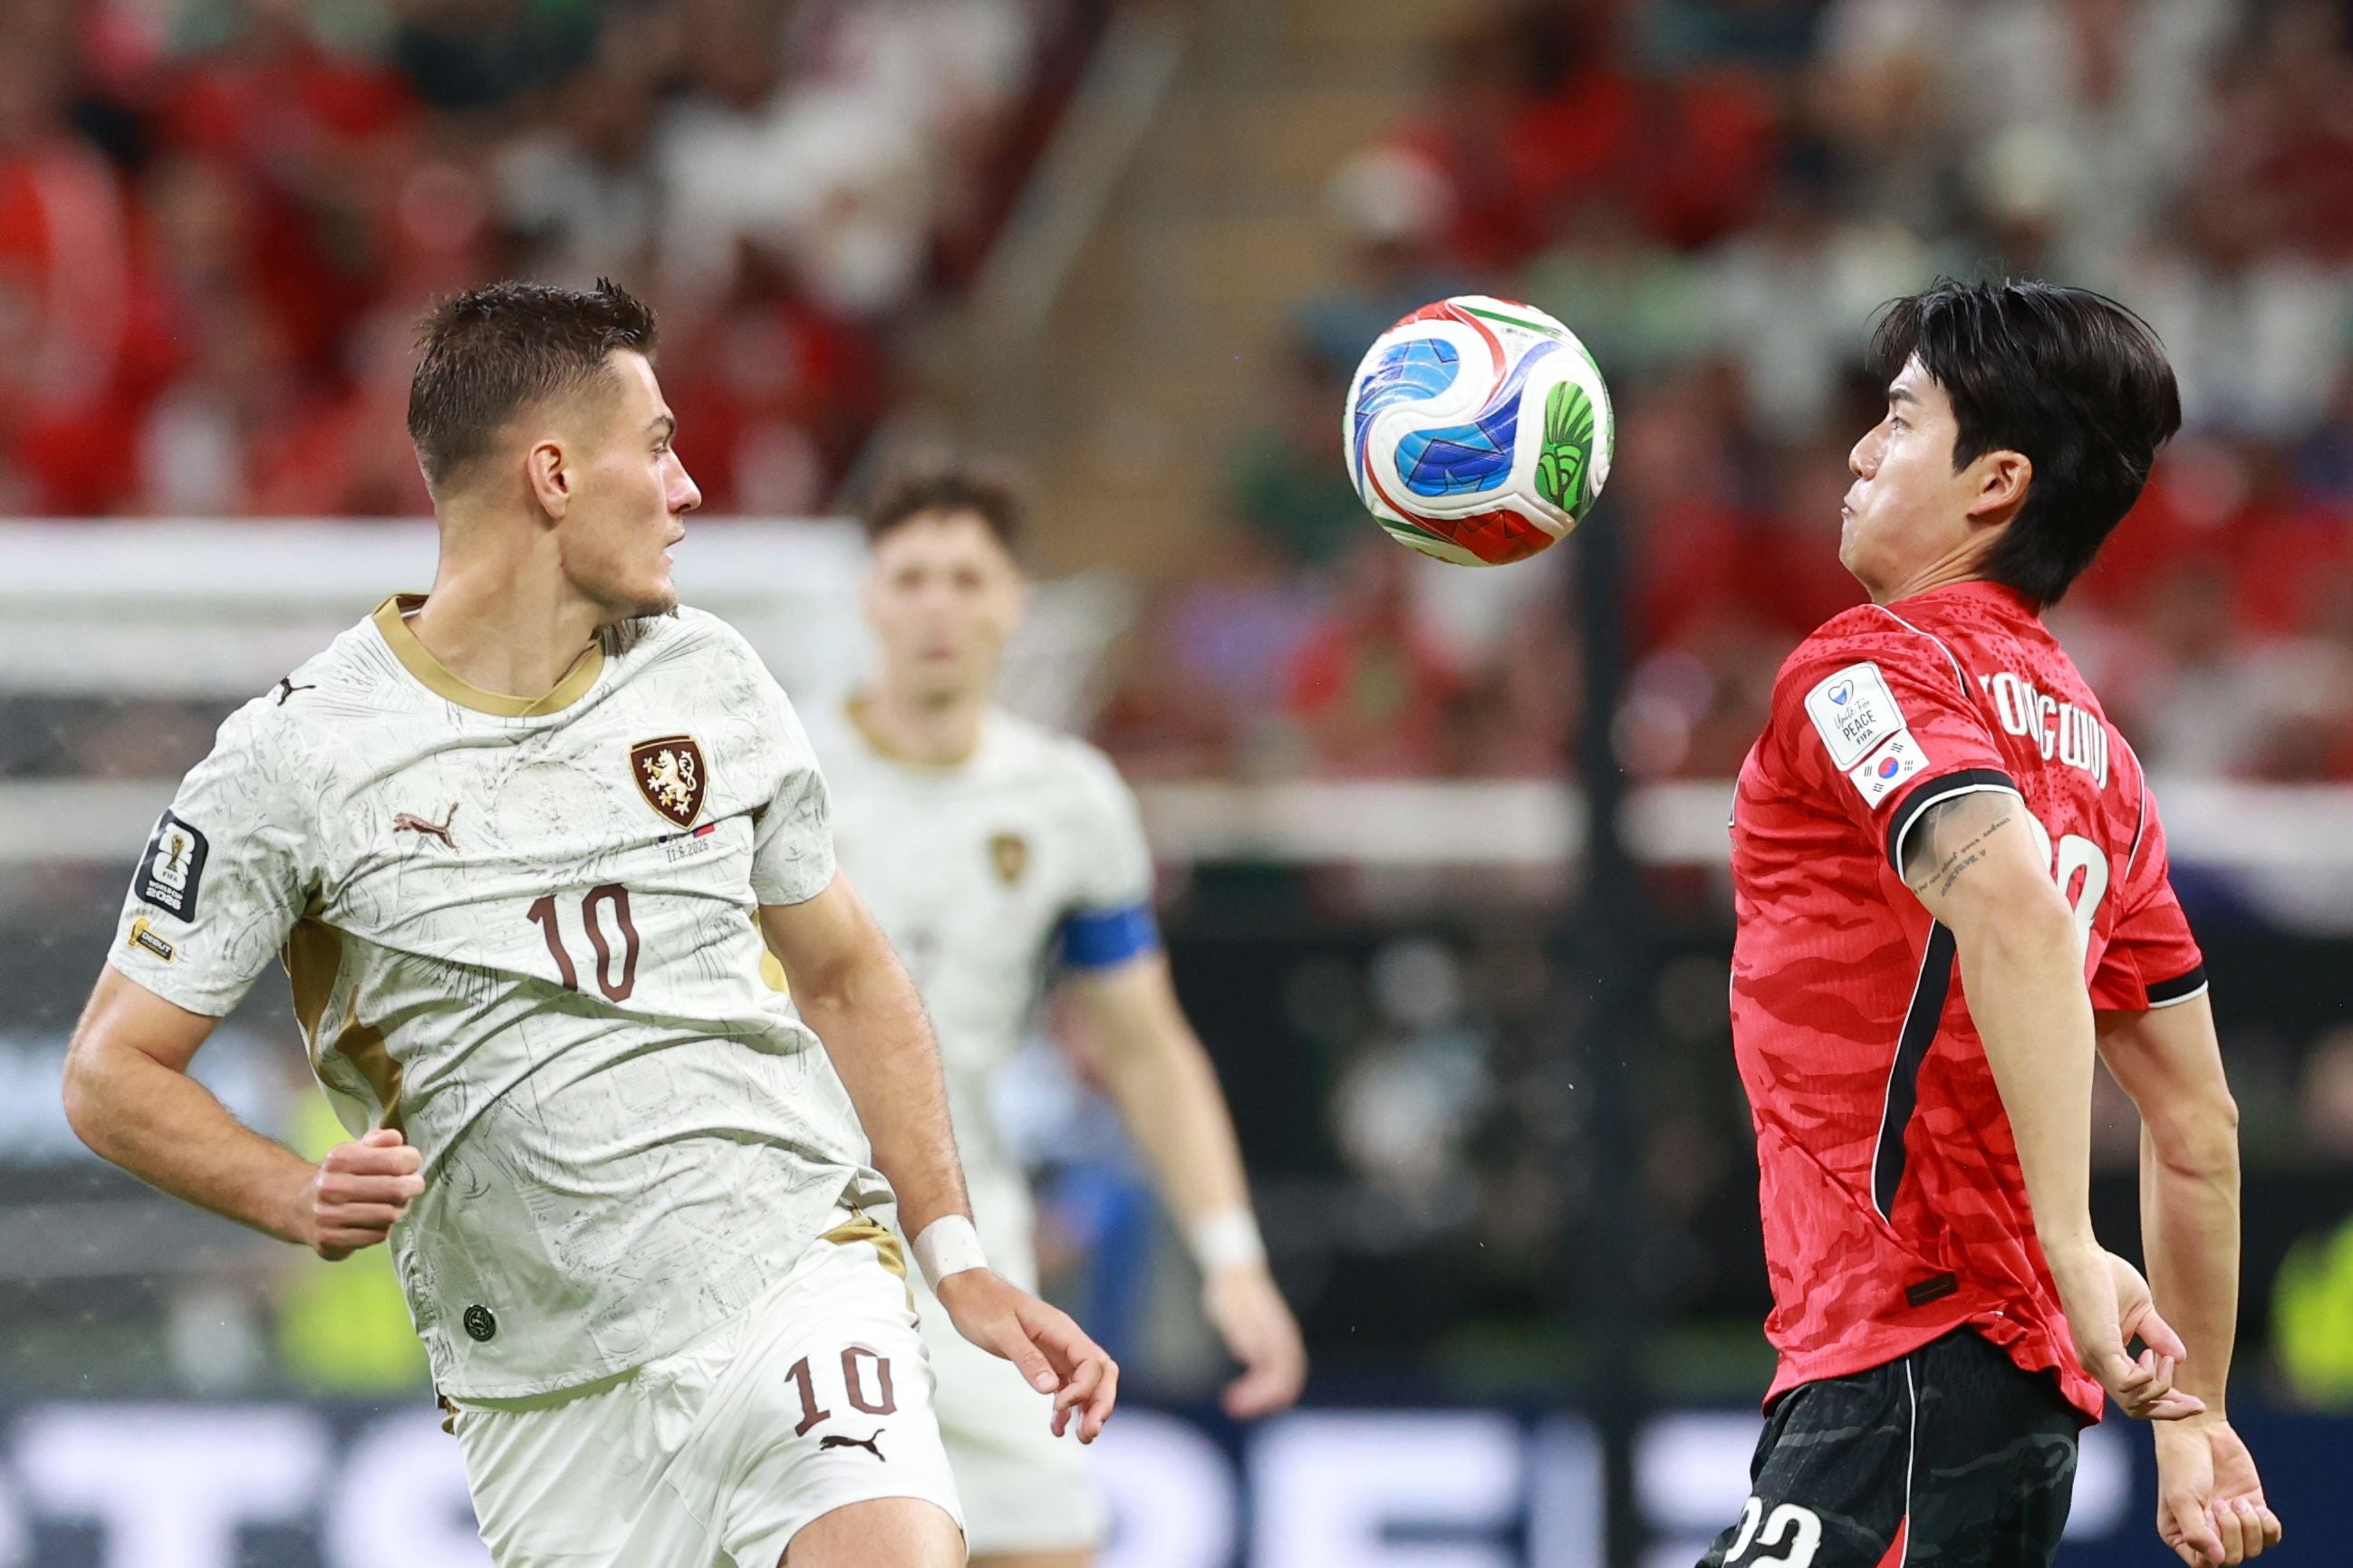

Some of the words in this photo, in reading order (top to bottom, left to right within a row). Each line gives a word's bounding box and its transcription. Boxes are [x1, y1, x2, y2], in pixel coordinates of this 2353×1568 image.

[1843, 709, 1876, 741] PEACE
[1856, 729, 1874, 745] FIFA
[666, 838, 709, 862] 11.6.2026
[149, 880, 171, 894] WORLD
[161, 871, 178, 883] FIFA
[146, 887, 181, 910] 2026
[141, 931, 172, 953] DEBUT
[526, 882, 640, 1003] 10
[784, 1346, 898, 1438] 10
